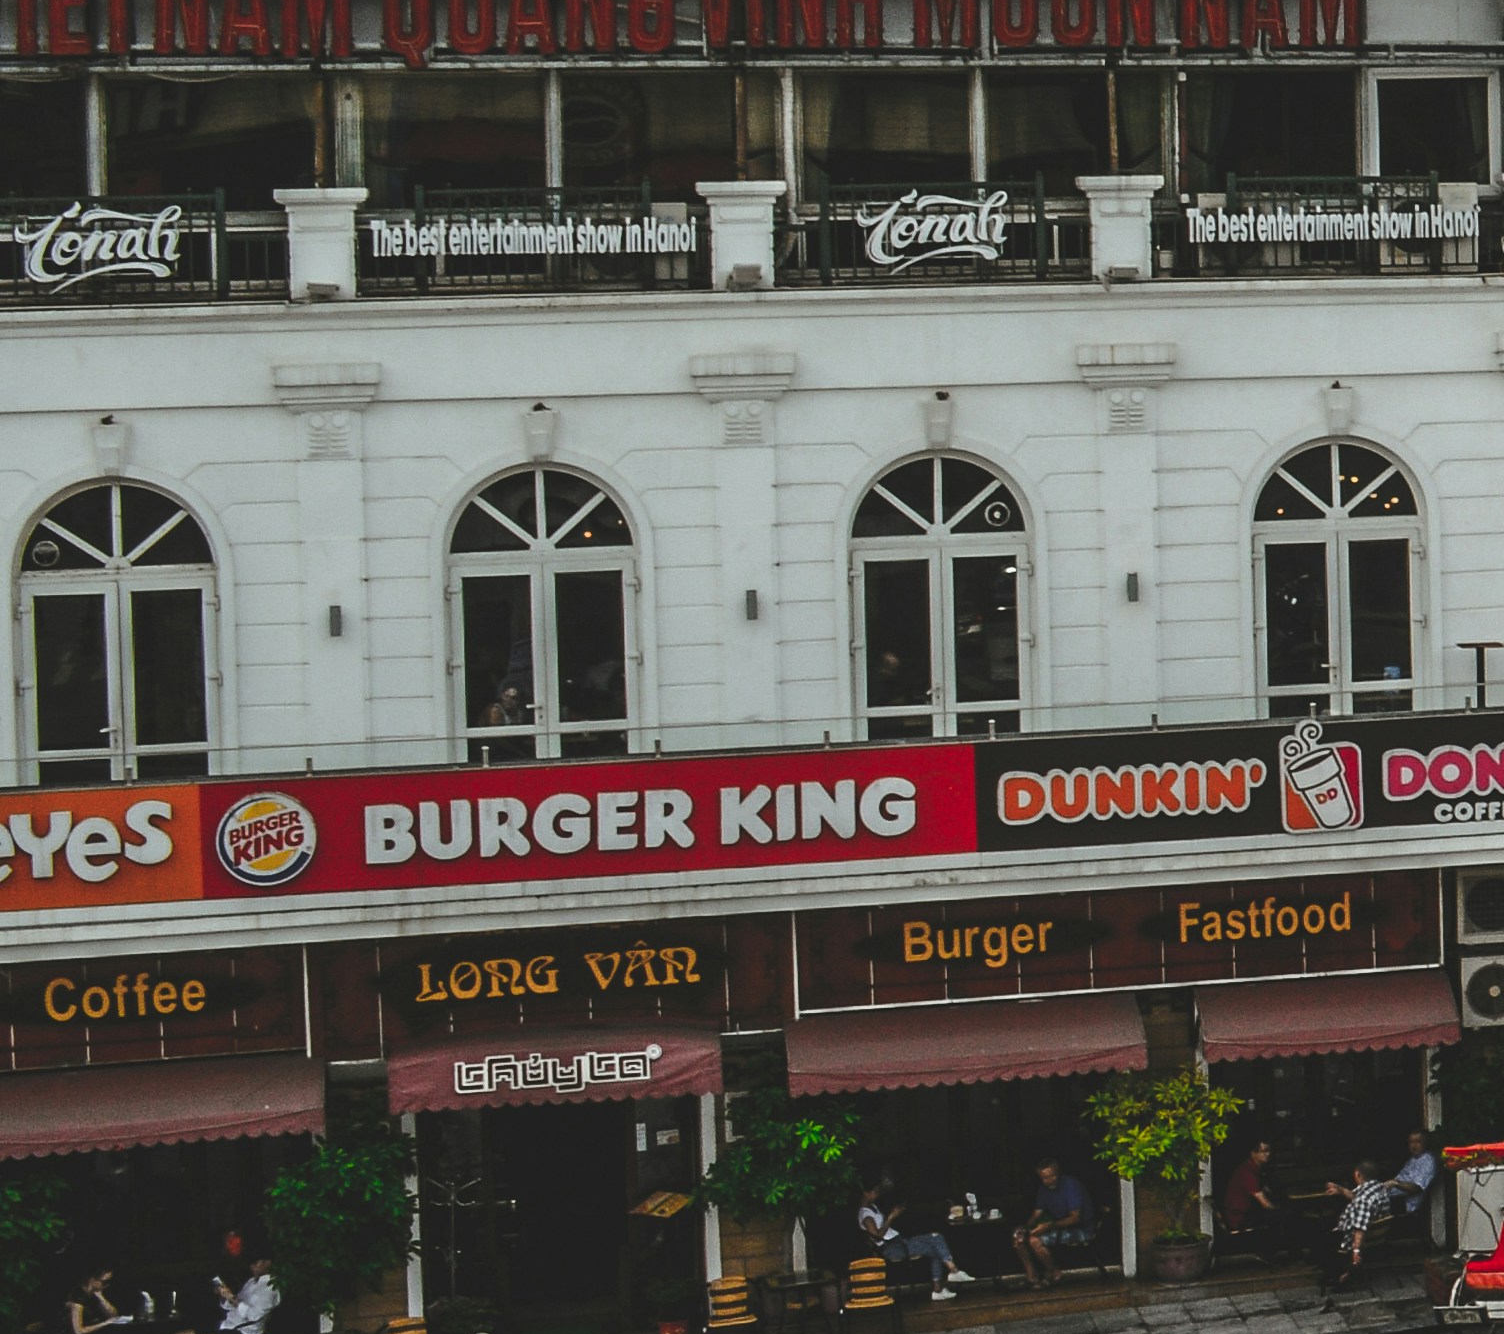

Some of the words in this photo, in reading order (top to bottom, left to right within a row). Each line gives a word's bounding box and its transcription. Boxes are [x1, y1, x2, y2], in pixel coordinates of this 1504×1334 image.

[370, 219, 402, 257] The
[404, 217, 446, 256] best
[448, 218, 574, 255] entertainment
[576, 219, 623, 254] show
[624, 217, 644, 253] in
[645, 215, 697, 253] Hanoi
[1186, 207, 1216, 244] The
[1217, 206, 1257, 243] best
[1258, 206, 1370, 243] entertainment
[1371, 205, 1413, 241] show
[1414, 204, 1430, 241] in
[1430, 202, 1480, 240] Hanoi
[998, 758, 1267, 827] DUNKIN'
[229, 810, 301, 846] BURGER
[365, 789, 695, 865] BURGER
[720, 776, 917, 845] KING
[232, 825, 305, 867] KING
[1178, 891, 1351, 944] Fastfood
[903, 920, 1053, 968] Burger
[415, 955, 559, 1003] LONG
[583, 939, 700, 991] VÂN
[44, 973, 207, 1022] Coffee
